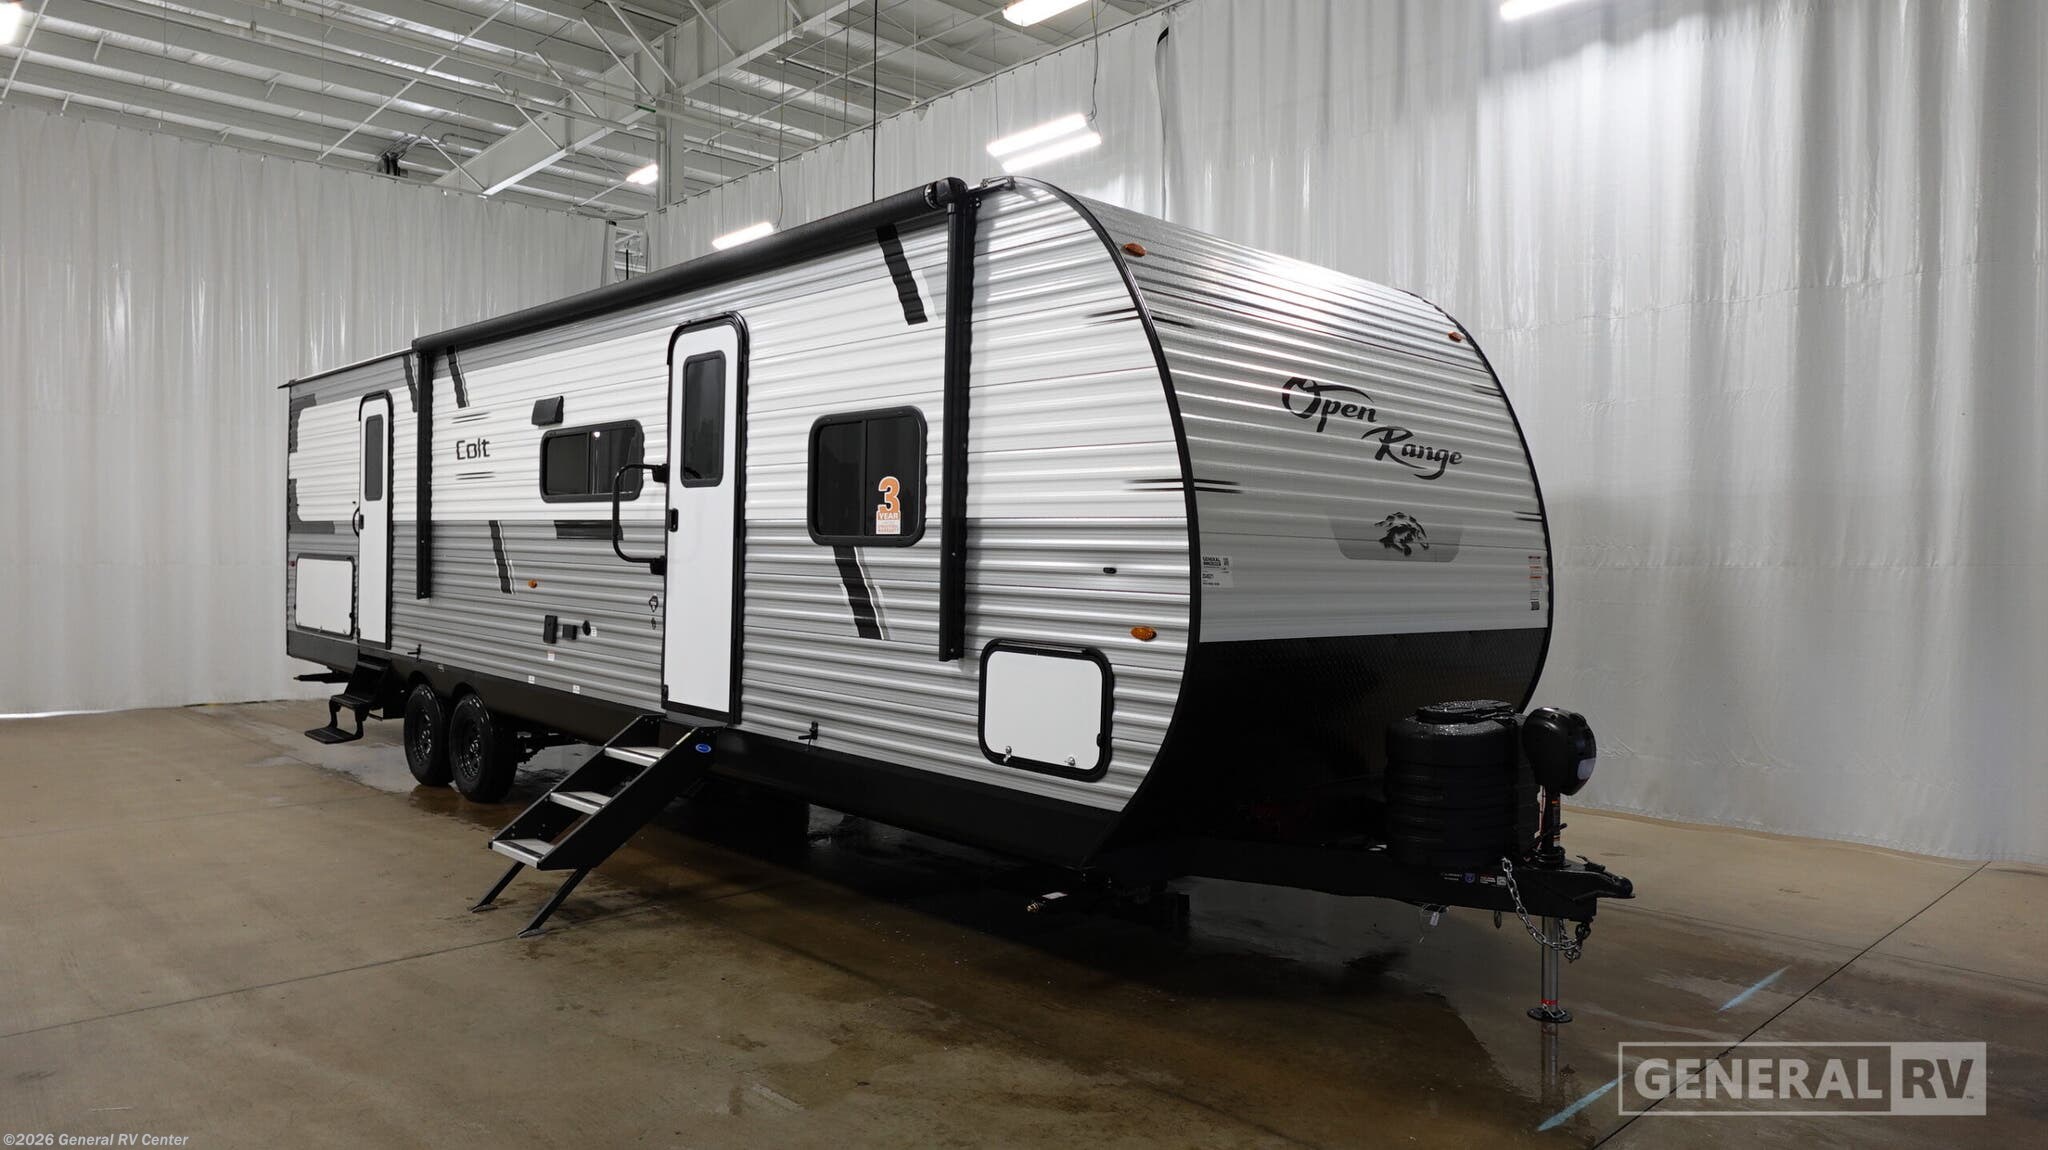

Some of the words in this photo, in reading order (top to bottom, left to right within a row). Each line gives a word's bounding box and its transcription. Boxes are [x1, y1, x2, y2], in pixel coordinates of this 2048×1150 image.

[1282, 377, 1377, 432] Open
[456, 438, 491, 460] Colt
[1361, 426, 1464, 480] Range
[878, 476, 900, 513] 3
[879, 512, 899, 520] YEAR
